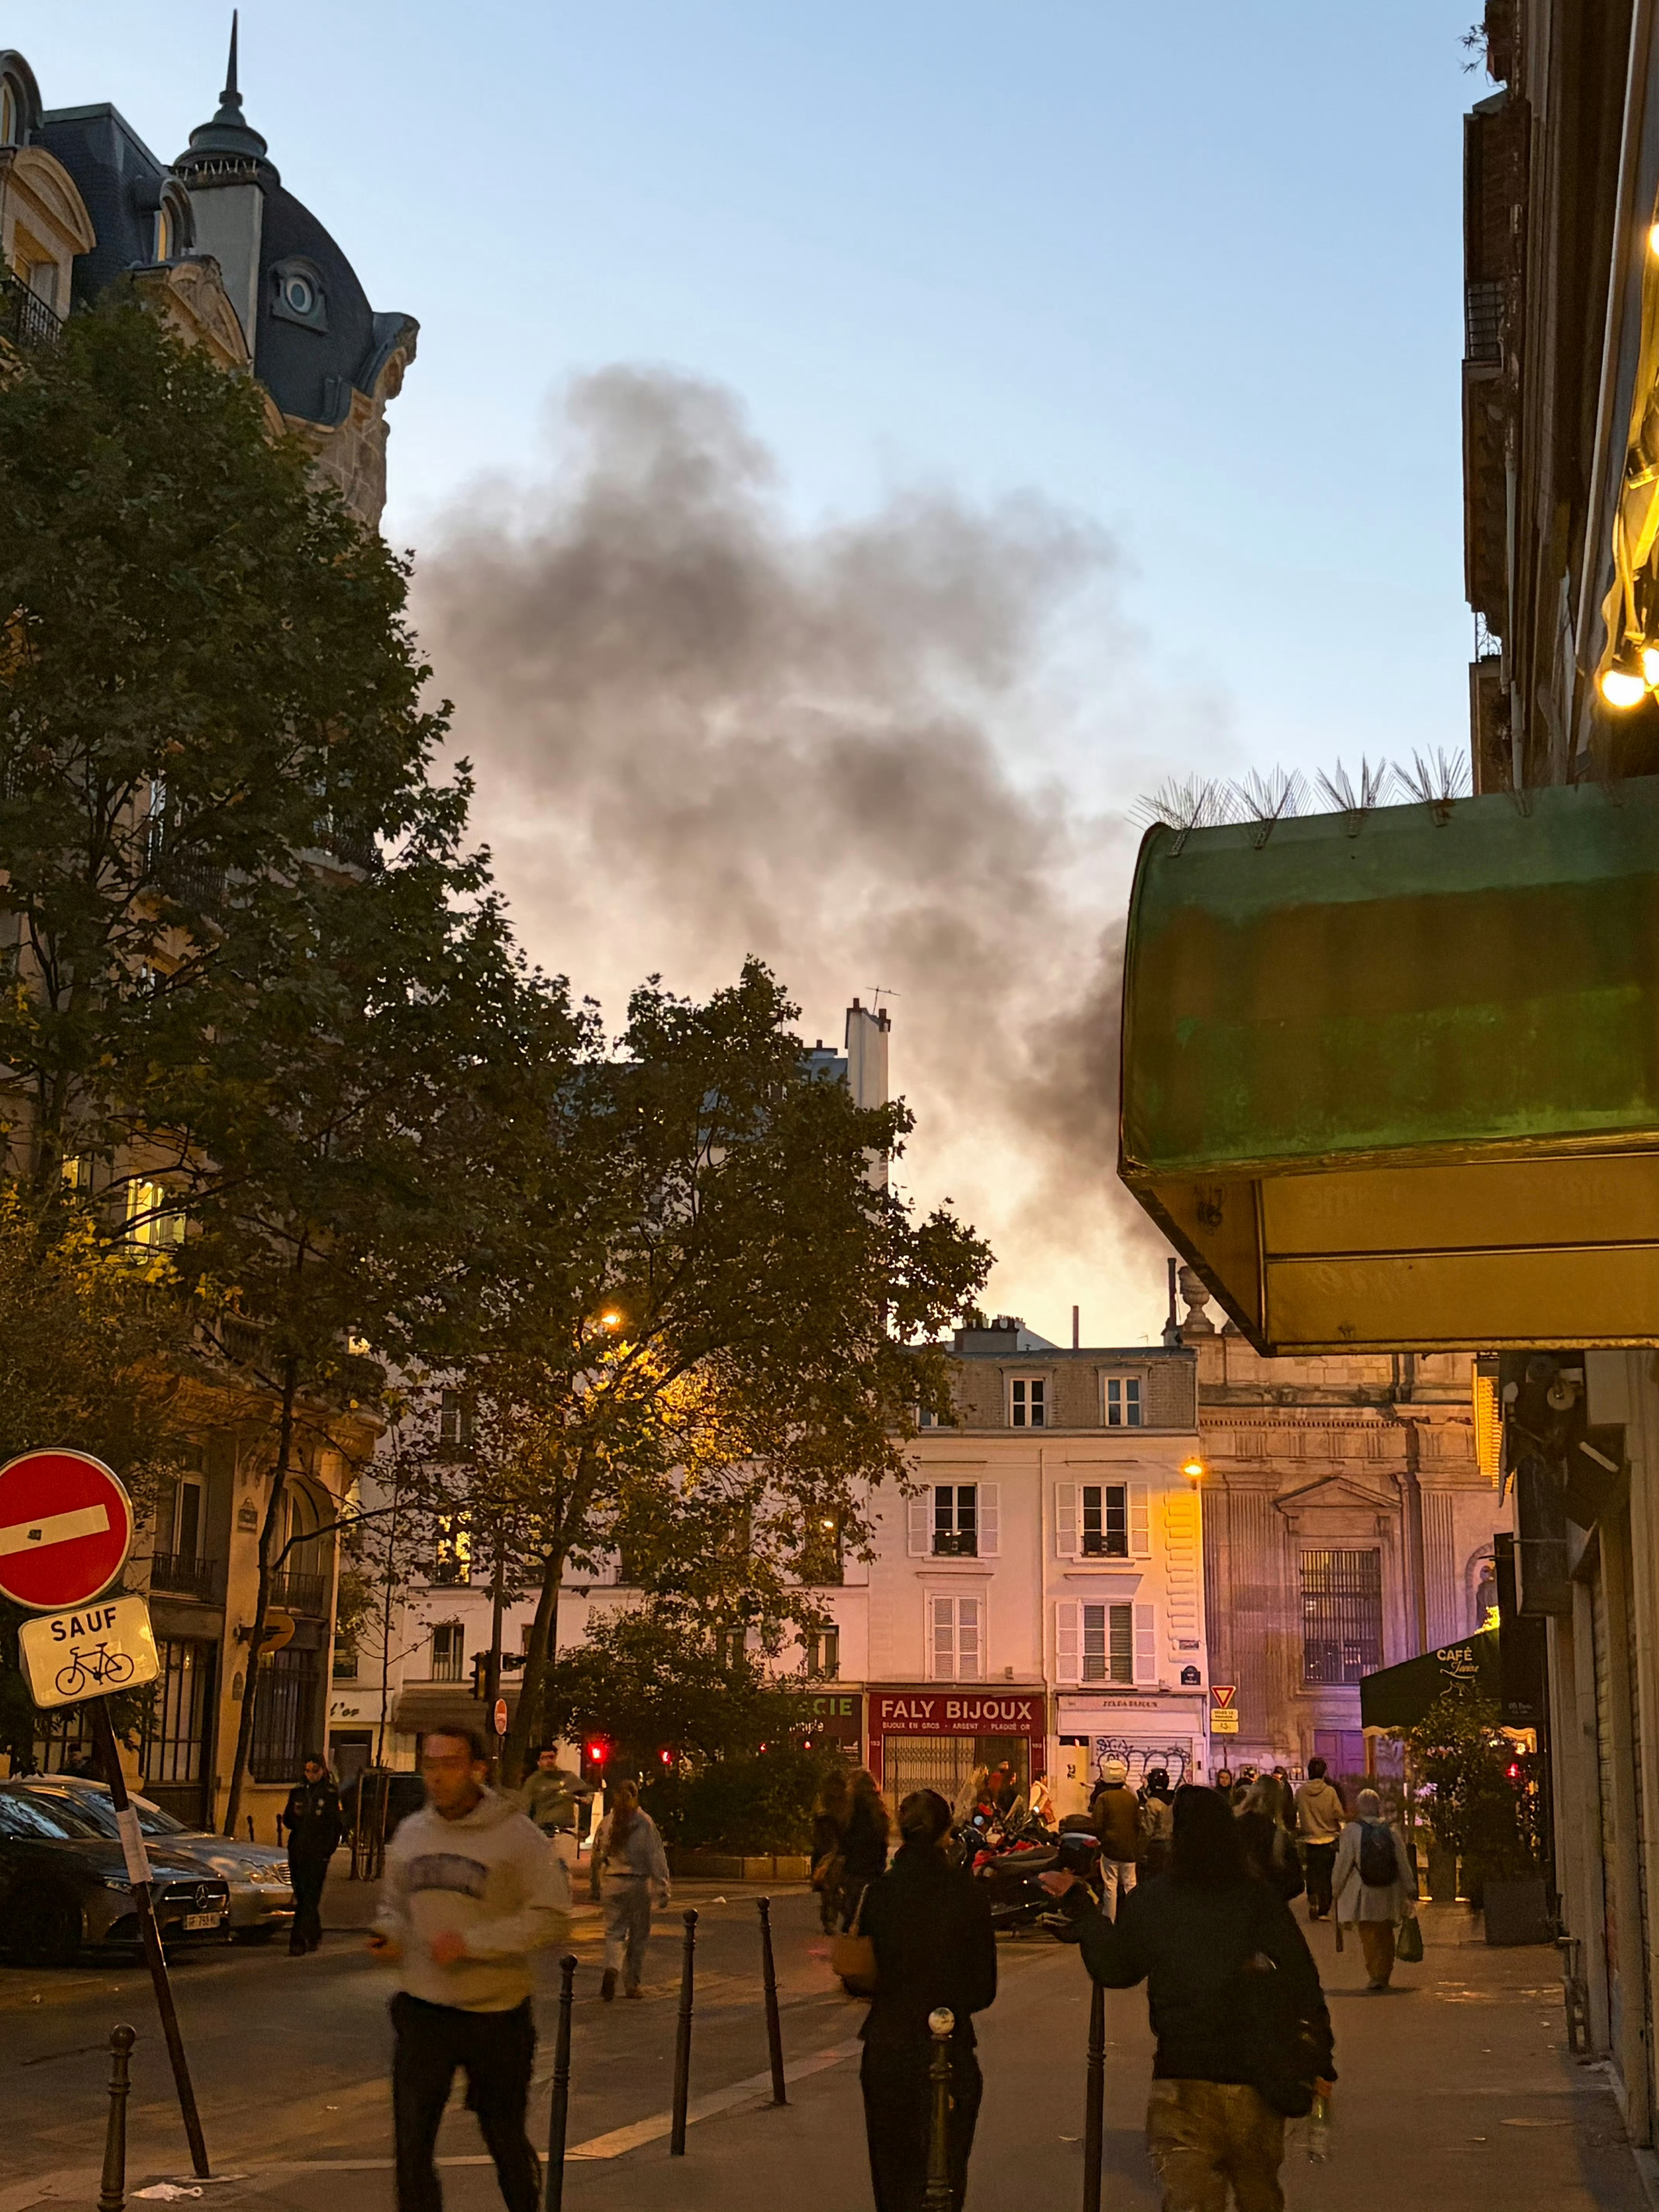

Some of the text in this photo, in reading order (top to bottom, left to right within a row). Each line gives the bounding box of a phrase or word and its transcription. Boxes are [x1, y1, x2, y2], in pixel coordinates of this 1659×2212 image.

[51, 1607, 116, 1641] SAUF
[1437, 1646, 1473, 1661] CAFÉ
[797, 1698, 852, 1716] CIE
[882, 1700, 1032, 1719] FALY BIJOUX
